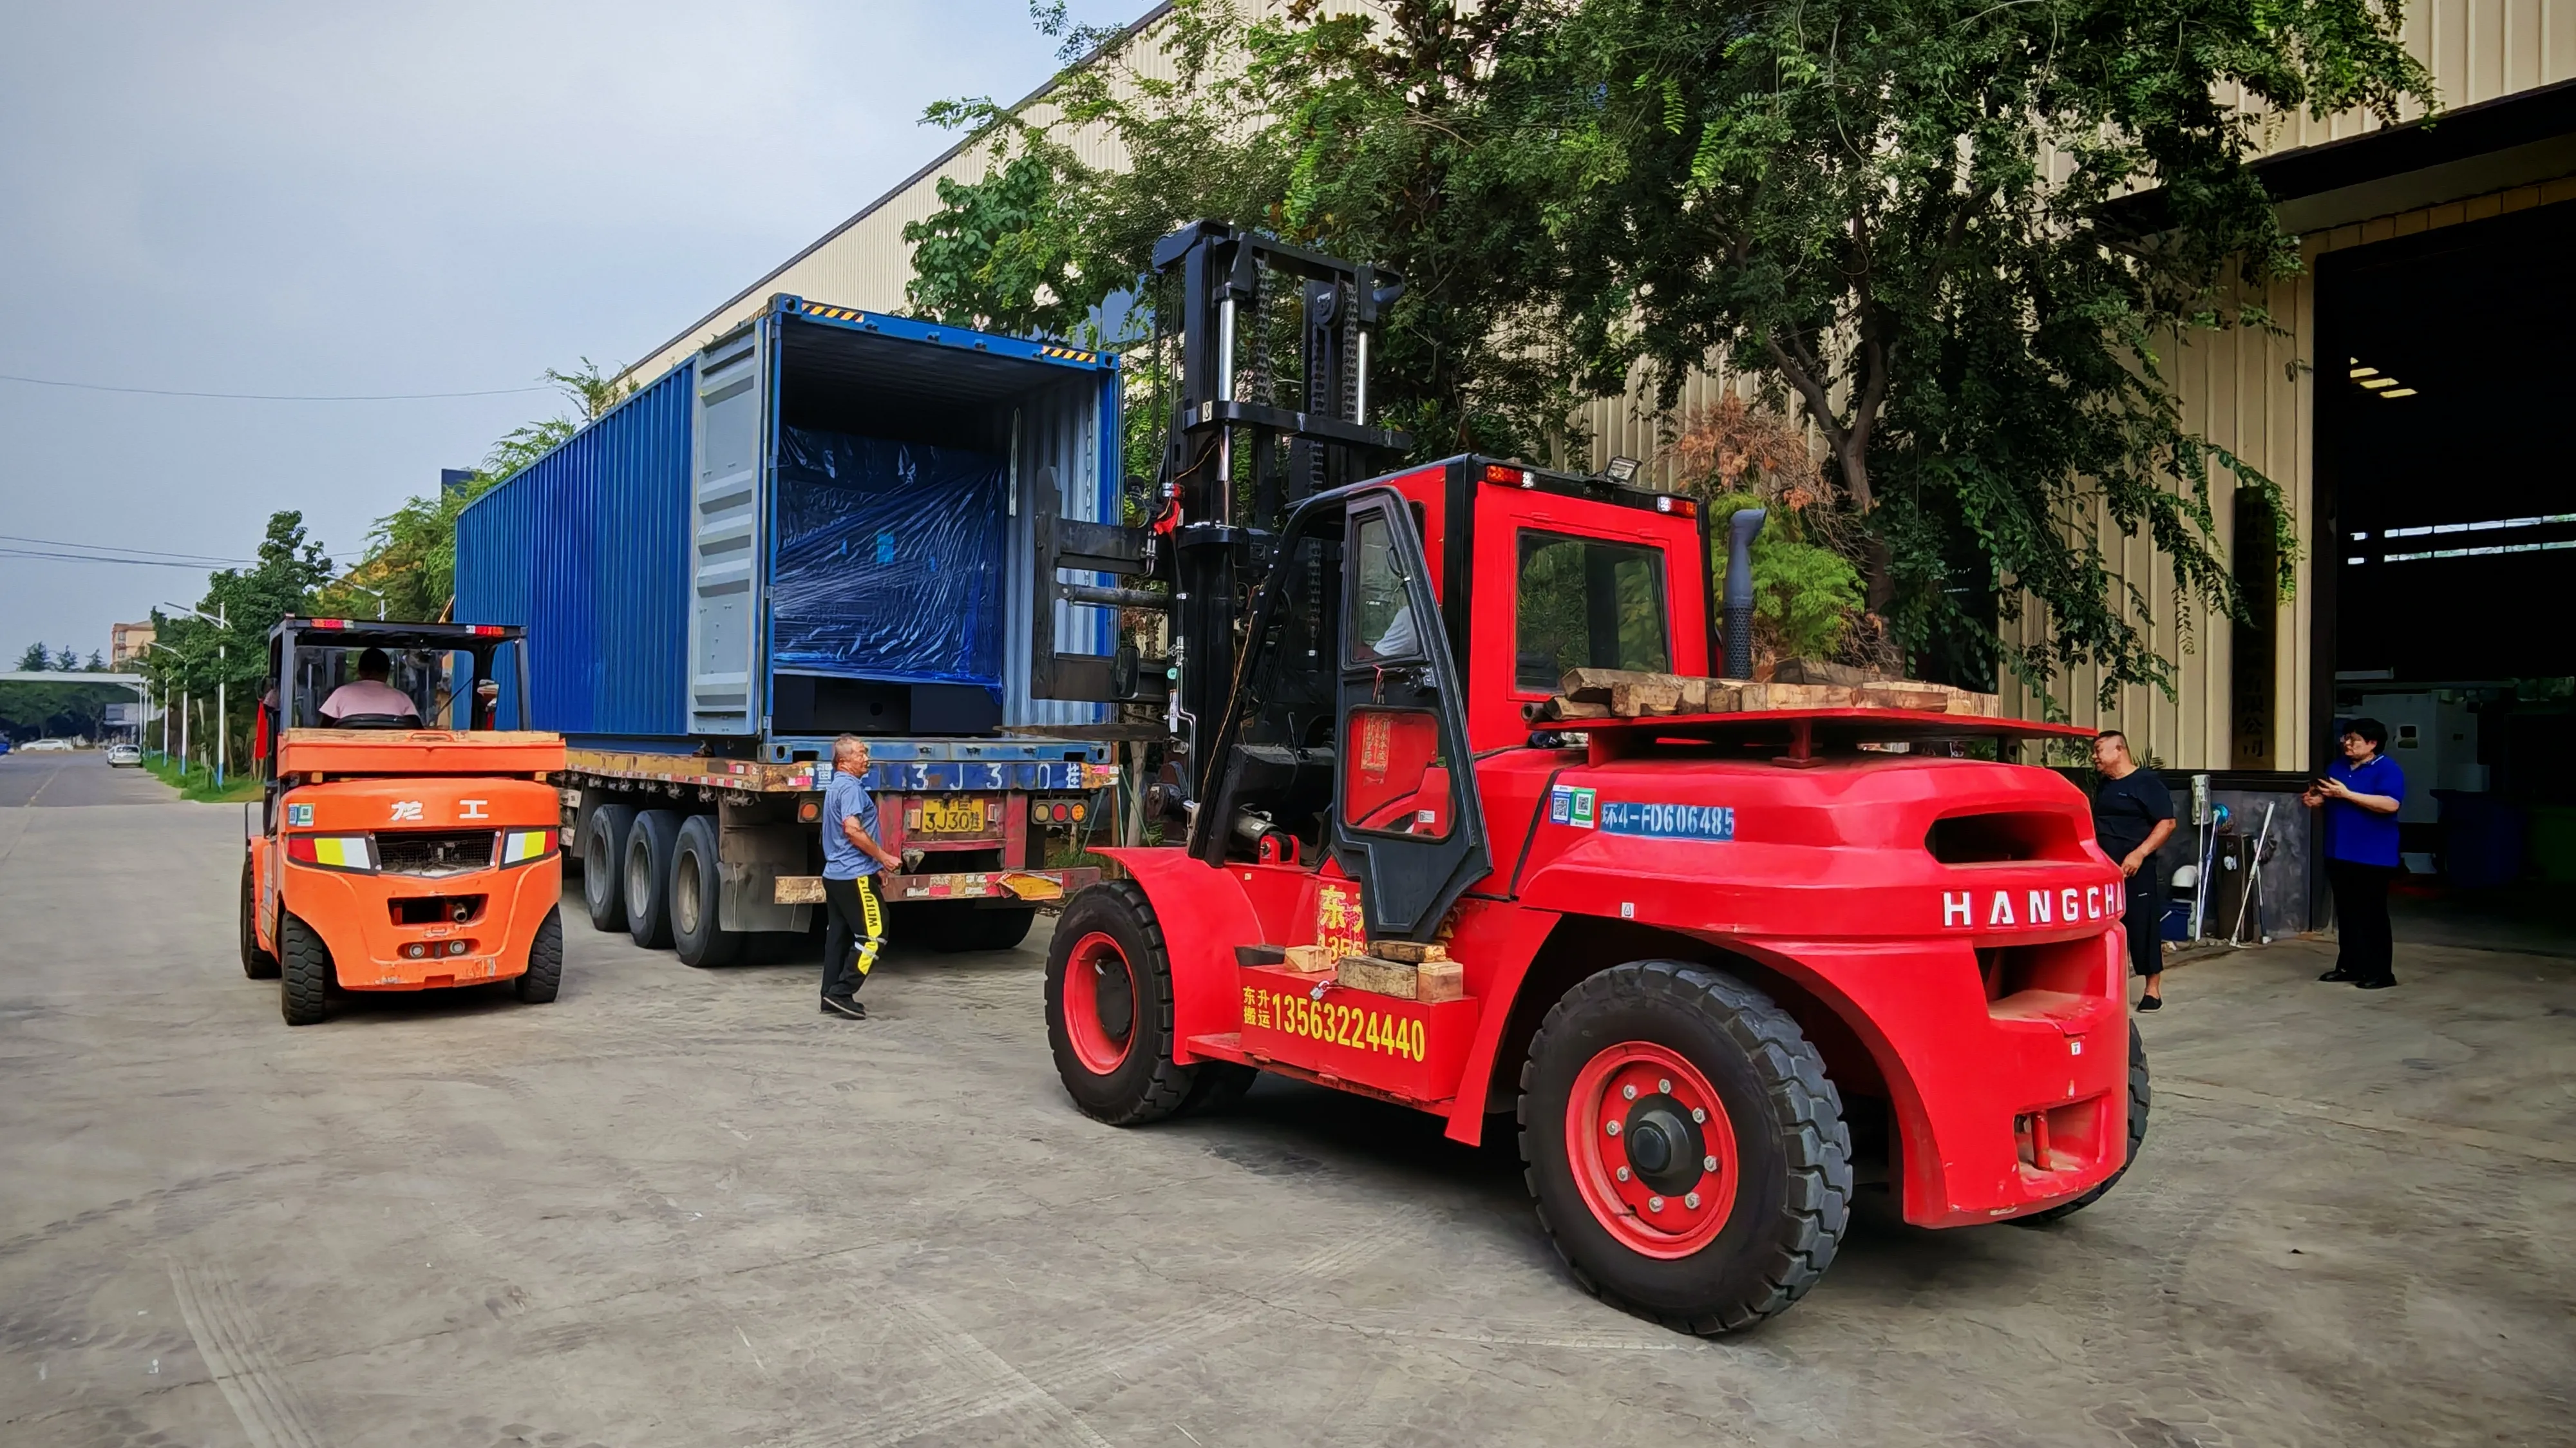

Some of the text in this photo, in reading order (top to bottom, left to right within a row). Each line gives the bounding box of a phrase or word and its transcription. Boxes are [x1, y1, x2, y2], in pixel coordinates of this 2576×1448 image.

[390, 799, 489, 821] 龙工
[1944, 881, 2123, 926] HANGCHA
[1318, 934, 1368, 960] 1356
[1243, 986, 1270, 1009] 东升
[1244, 1006, 1271, 1029] 搬运
[1273, 993, 1425, 1062] 13563224440
